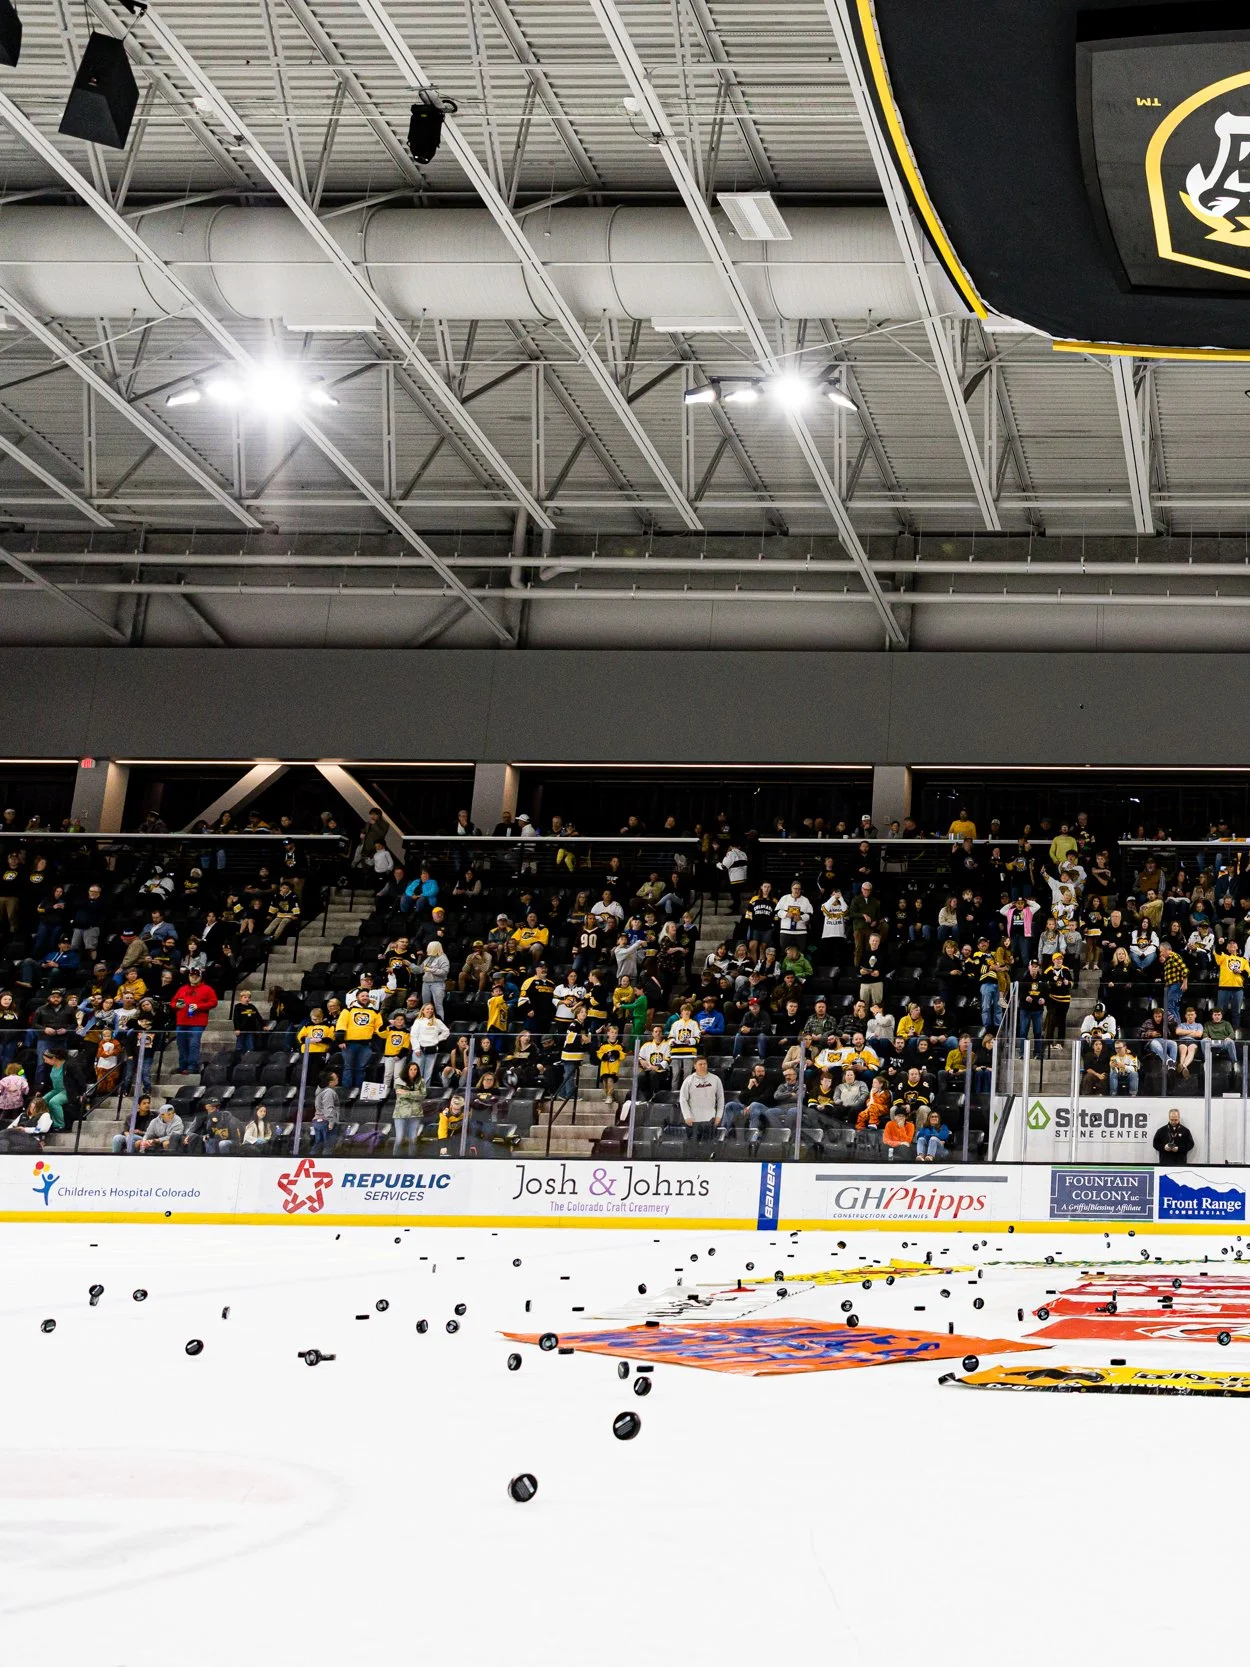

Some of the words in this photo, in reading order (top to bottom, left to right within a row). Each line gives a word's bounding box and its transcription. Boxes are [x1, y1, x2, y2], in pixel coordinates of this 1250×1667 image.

[580, 933, 598, 949] 90
[1055, 1107, 1148, 1129] SteOne
[1055, 1130, 1094, 1138] STNE
[1101, 1130, 1148, 1139] CENTER
[341, 1173, 451, 1189] REPUBLIC
[512, 1163, 578, 1200] Josh
[588, 1168, 617, 1196] &
[620, 1164, 710, 1201] John's
[1065, 1176, 1139, 1187] FOUNTAIN
[58, 1186, 107, 1197] Children's
[110, 1187, 153, 1198] Hospital
[155, 1187, 201, 1198] Colorado
[364, 1191, 425, 1201] SERVICES
[1072, 1190, 1131, 1201] COLONY
[550, 1201, 565, 1212] The
[566, 1201, 604, 1212] Colorado
[606, 1202, 627, 1213] Craft
[628, 1202, 670, 1215] Creamery
[1116, 1204, 1141, 1212] Affiliate
[1163, 1197, 1197, 1209] Front
[1202, 1198, 1242, 1213] Range
